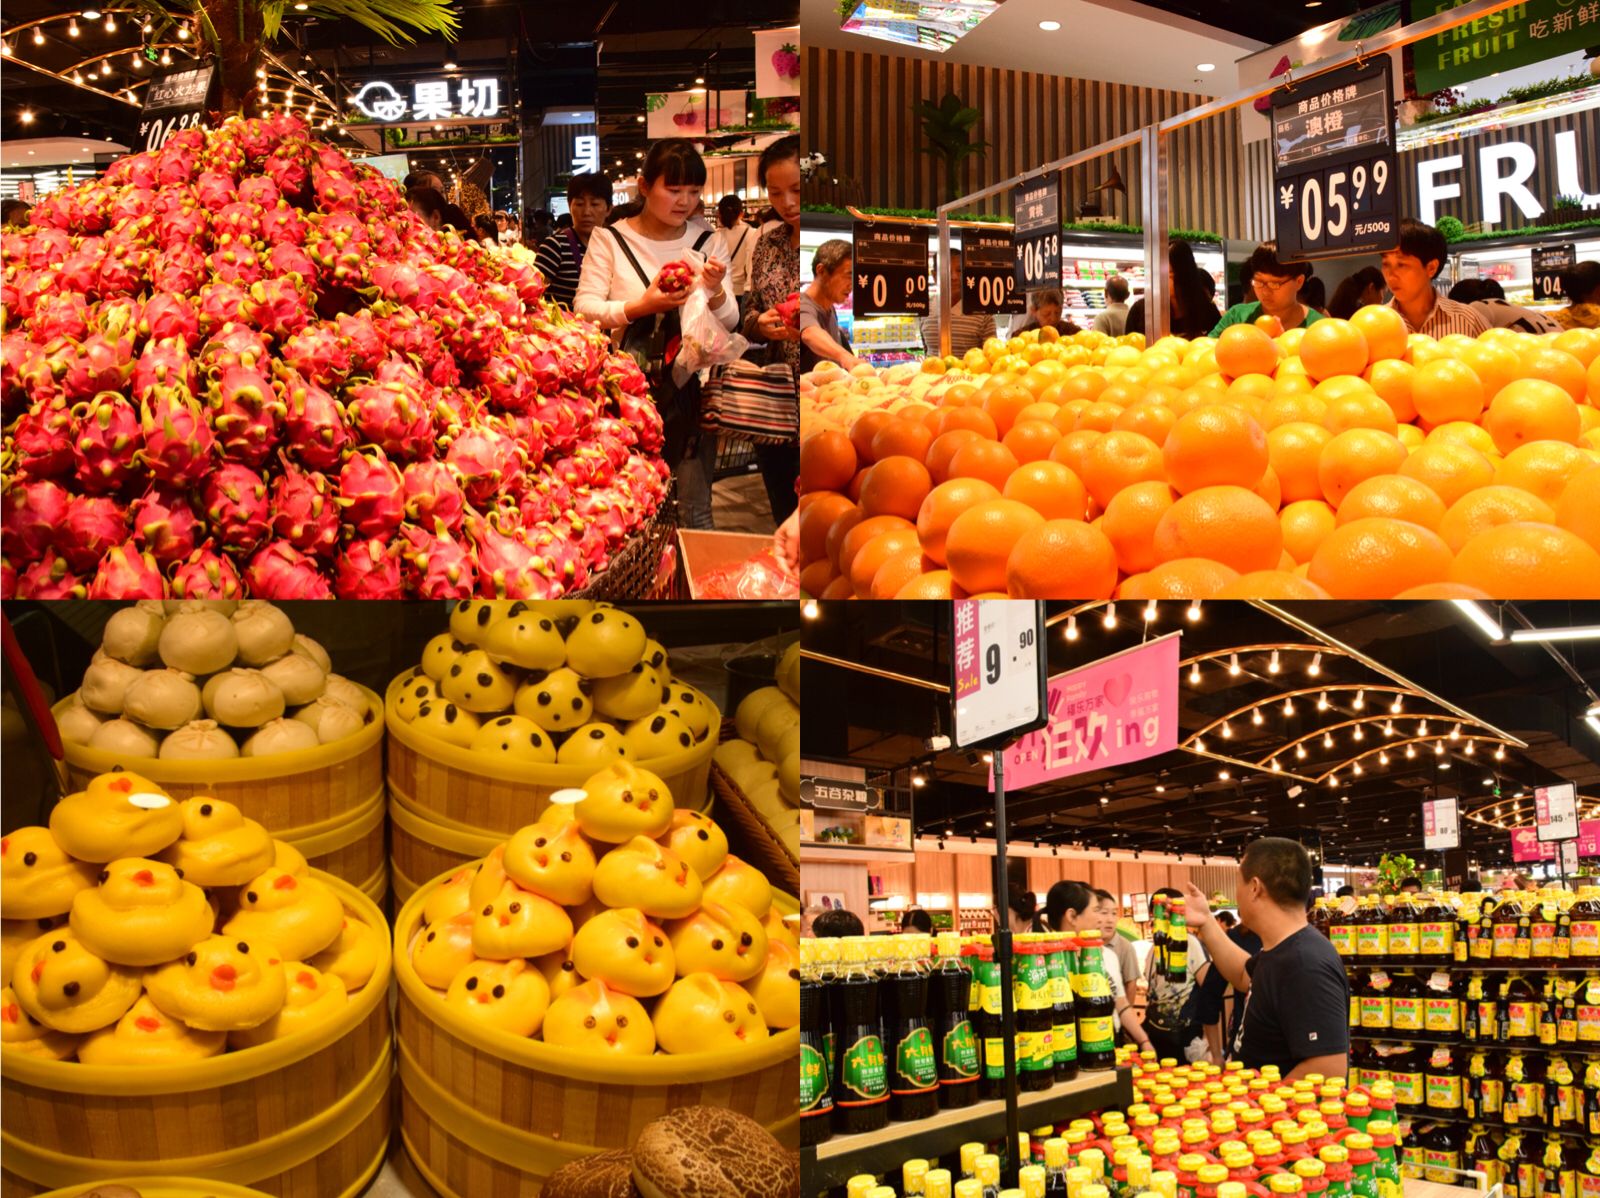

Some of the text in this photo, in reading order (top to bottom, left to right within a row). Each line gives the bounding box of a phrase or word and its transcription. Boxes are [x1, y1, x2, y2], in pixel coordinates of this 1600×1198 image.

[1529, 1, 1600, 39] 吃新鲜
[1438, 29, 1520, 71] FRUIT
[412, 78, 498, 120] 果切
[1297, 84, 1358, 115] 商品价格牌
[1305, 109, 1344, 138] 澳橙
[1354, 221, 1390, 236] 元/500g
[956, 601, 975, 672] 推荐
[956, 672, 979, 693] Sale
[1116, 715, 1160, 748] ing
[1014, 749, 1039, 765] OPEN
